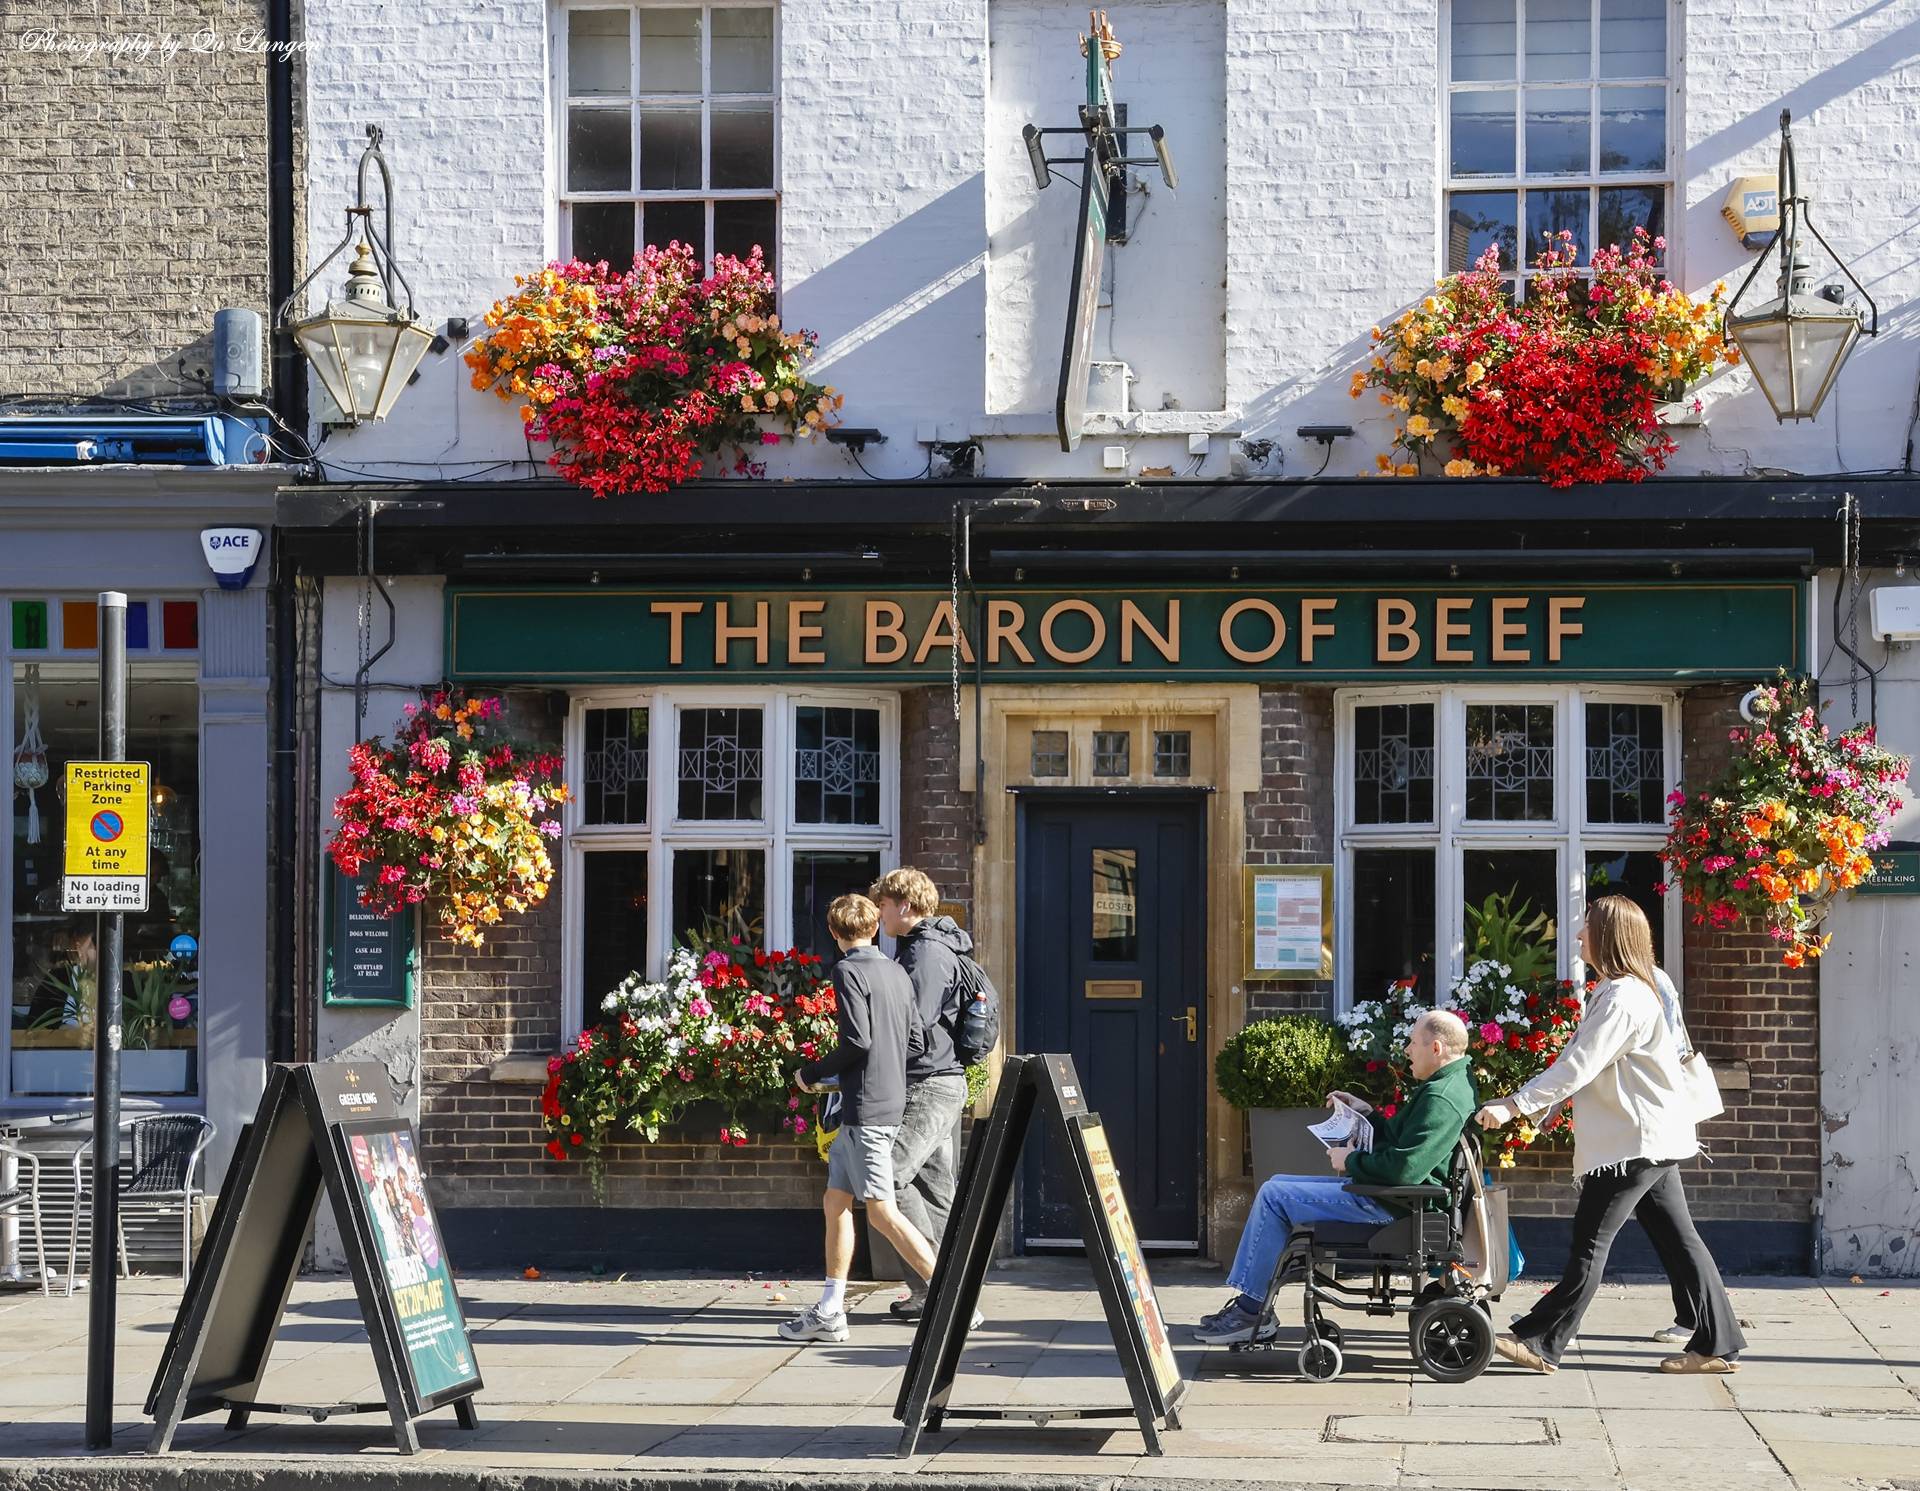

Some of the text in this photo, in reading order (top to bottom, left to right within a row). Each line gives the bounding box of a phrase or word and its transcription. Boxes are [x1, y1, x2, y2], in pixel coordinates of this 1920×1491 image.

[1745, 196, 1776, 212] ADT
[222, 536, 249, 548] ACE
[650, 596, 1586, 665] THE BARON OF BEEF
[74, 768, 141, 779] Restricted
[83, 781, 132, 793] Parking
[91, 794, 122, 805] Zone
[85, 847, 127, 858] At any
[91, 860, 120, 870] time
[71, 880, 140, 894] No loading
[68, 894, 142, 906] at any time
[1096, 900, 1134, 912] CLOSED
[338, 1092, 378, 1106] GREENE KING
[393, 1286, 411, 1318] GET
